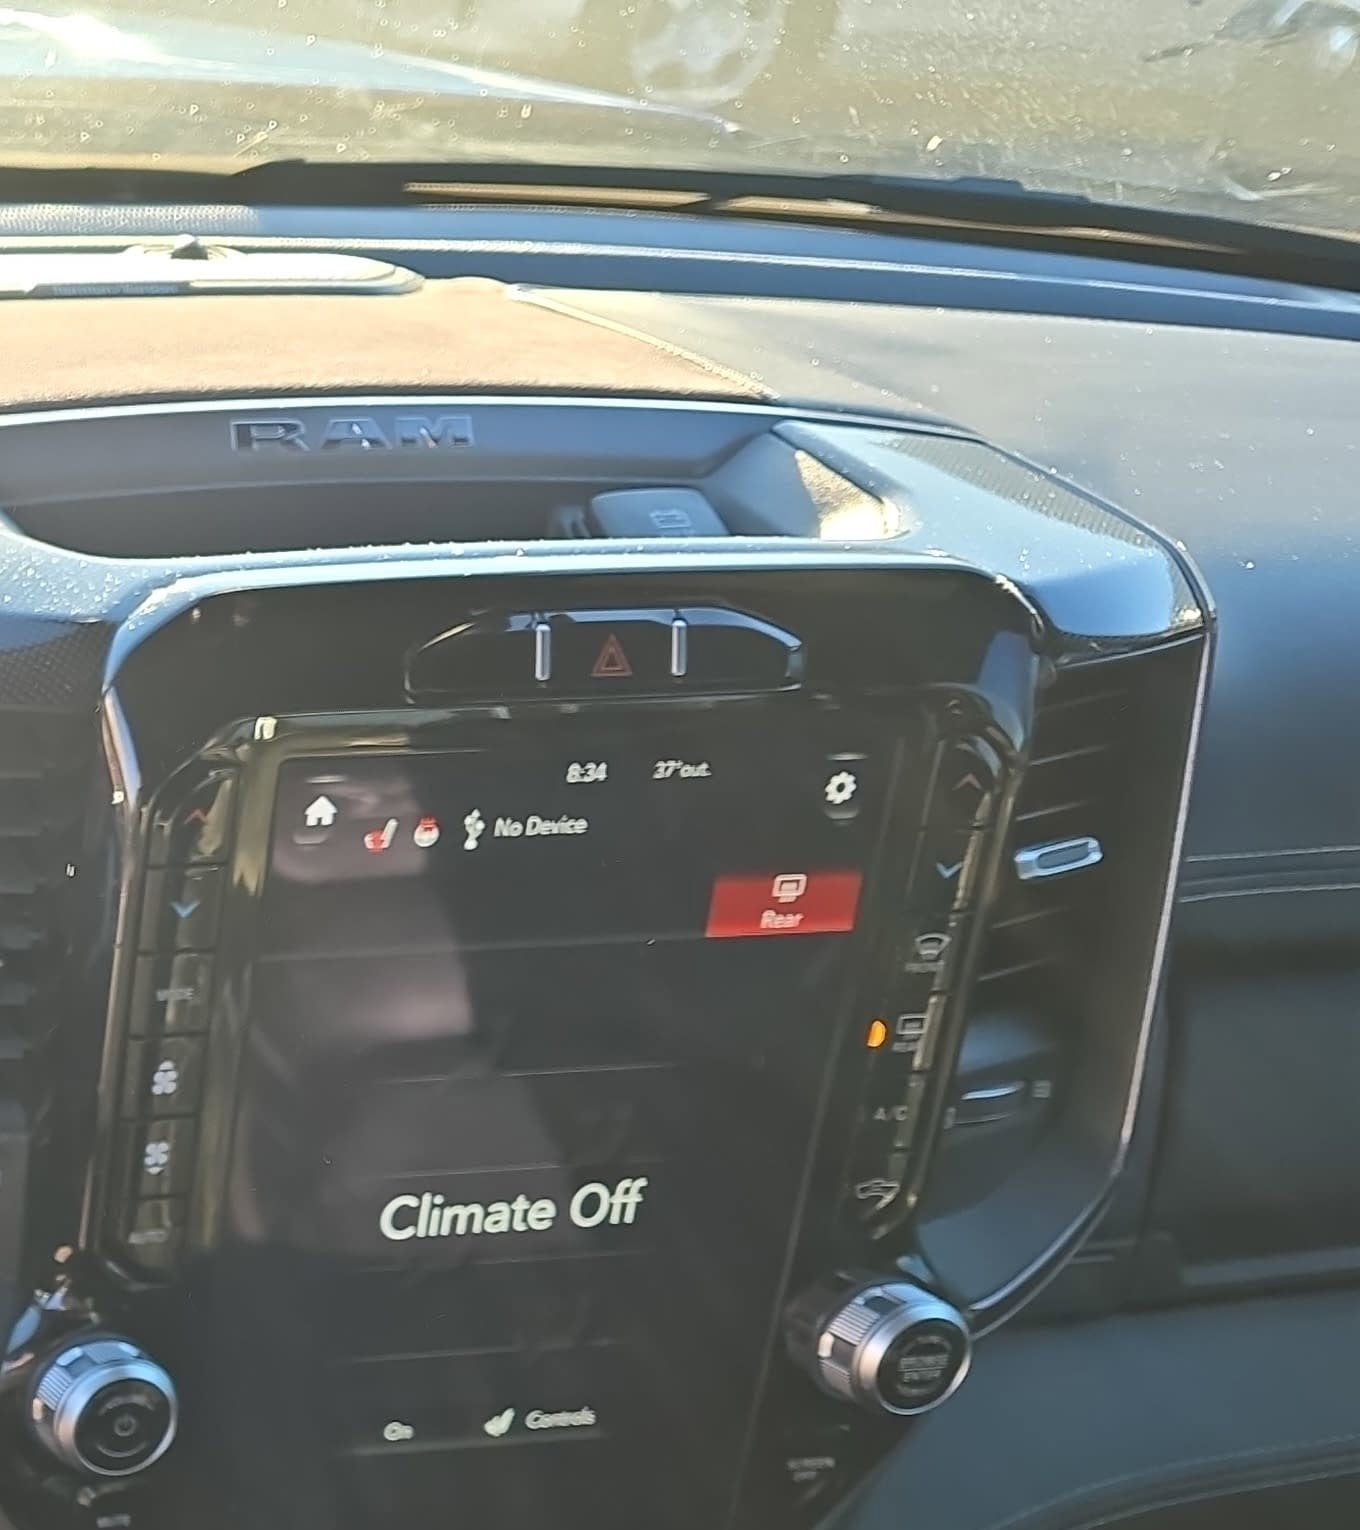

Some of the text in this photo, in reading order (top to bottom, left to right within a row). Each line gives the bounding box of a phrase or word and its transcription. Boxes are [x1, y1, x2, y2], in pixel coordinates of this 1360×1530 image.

[230, 415, 476, 452] RAM
[493, 813, 589, 837] No Device
[760, 909, 804, 930] Rear
[380, 1177, 648, 1240] Climate Off
